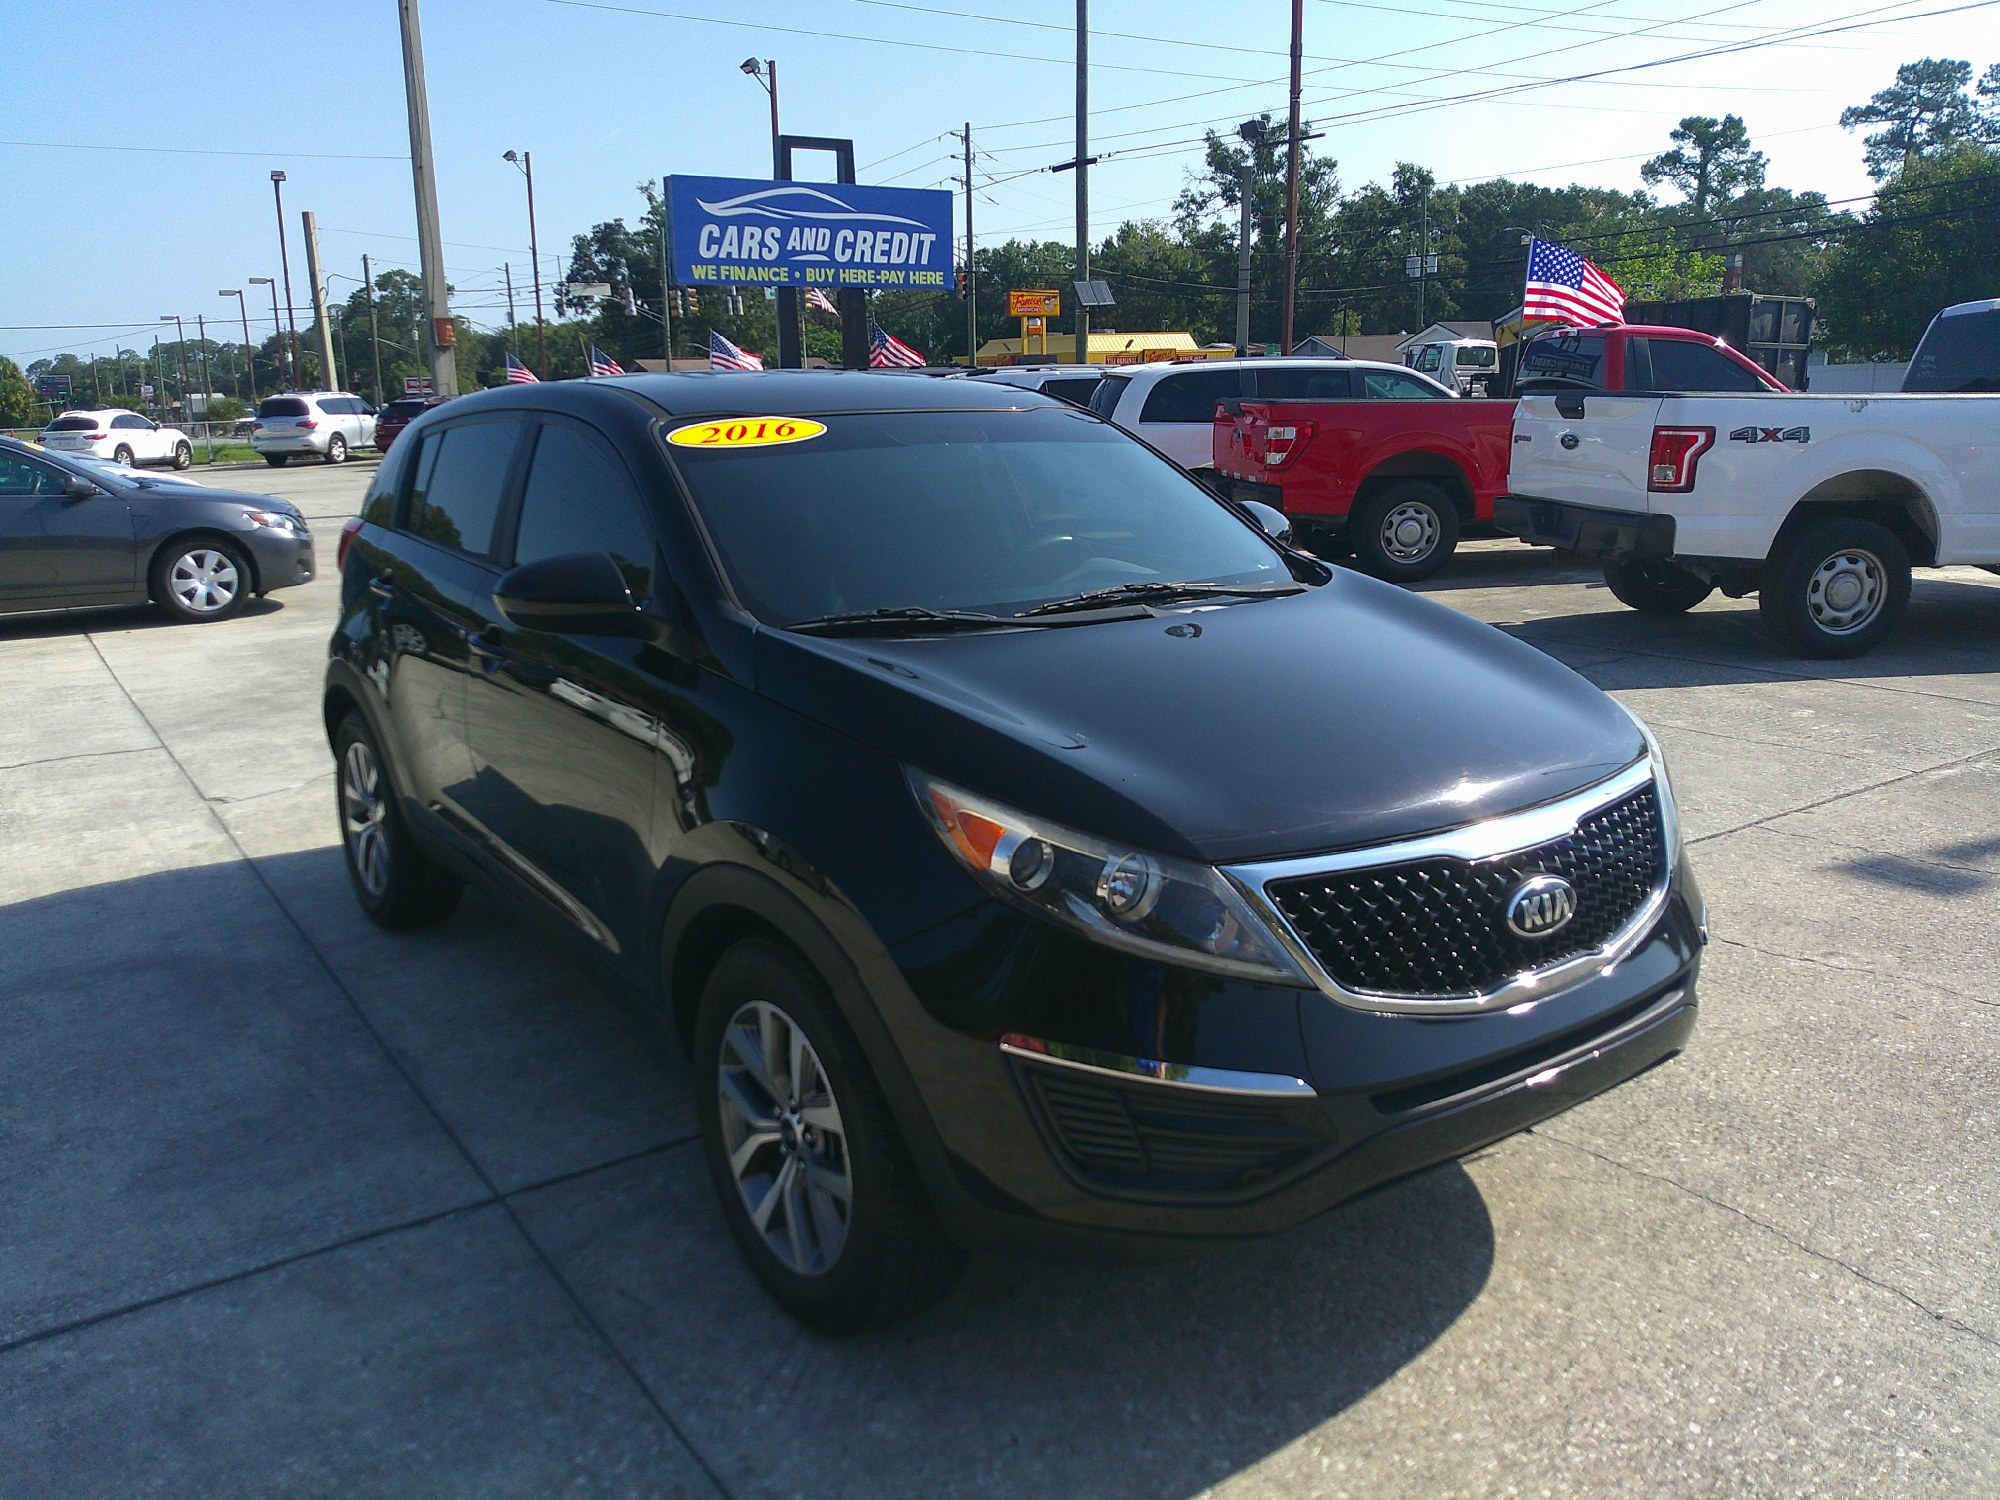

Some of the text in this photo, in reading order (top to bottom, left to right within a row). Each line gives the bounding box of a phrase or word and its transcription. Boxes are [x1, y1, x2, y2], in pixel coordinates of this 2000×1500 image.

[699, 224, 936, 265] CARS AND CREDIT
[691, 265, 717, 280] WE
[721, 265, 789, 281] FINANCE
[806, 268, 835, 282] BUY
[909, 270, 944, 285] HERE
[701, 421, 797, 443] 2016
[1520, 888, 1571, 929] KIA
